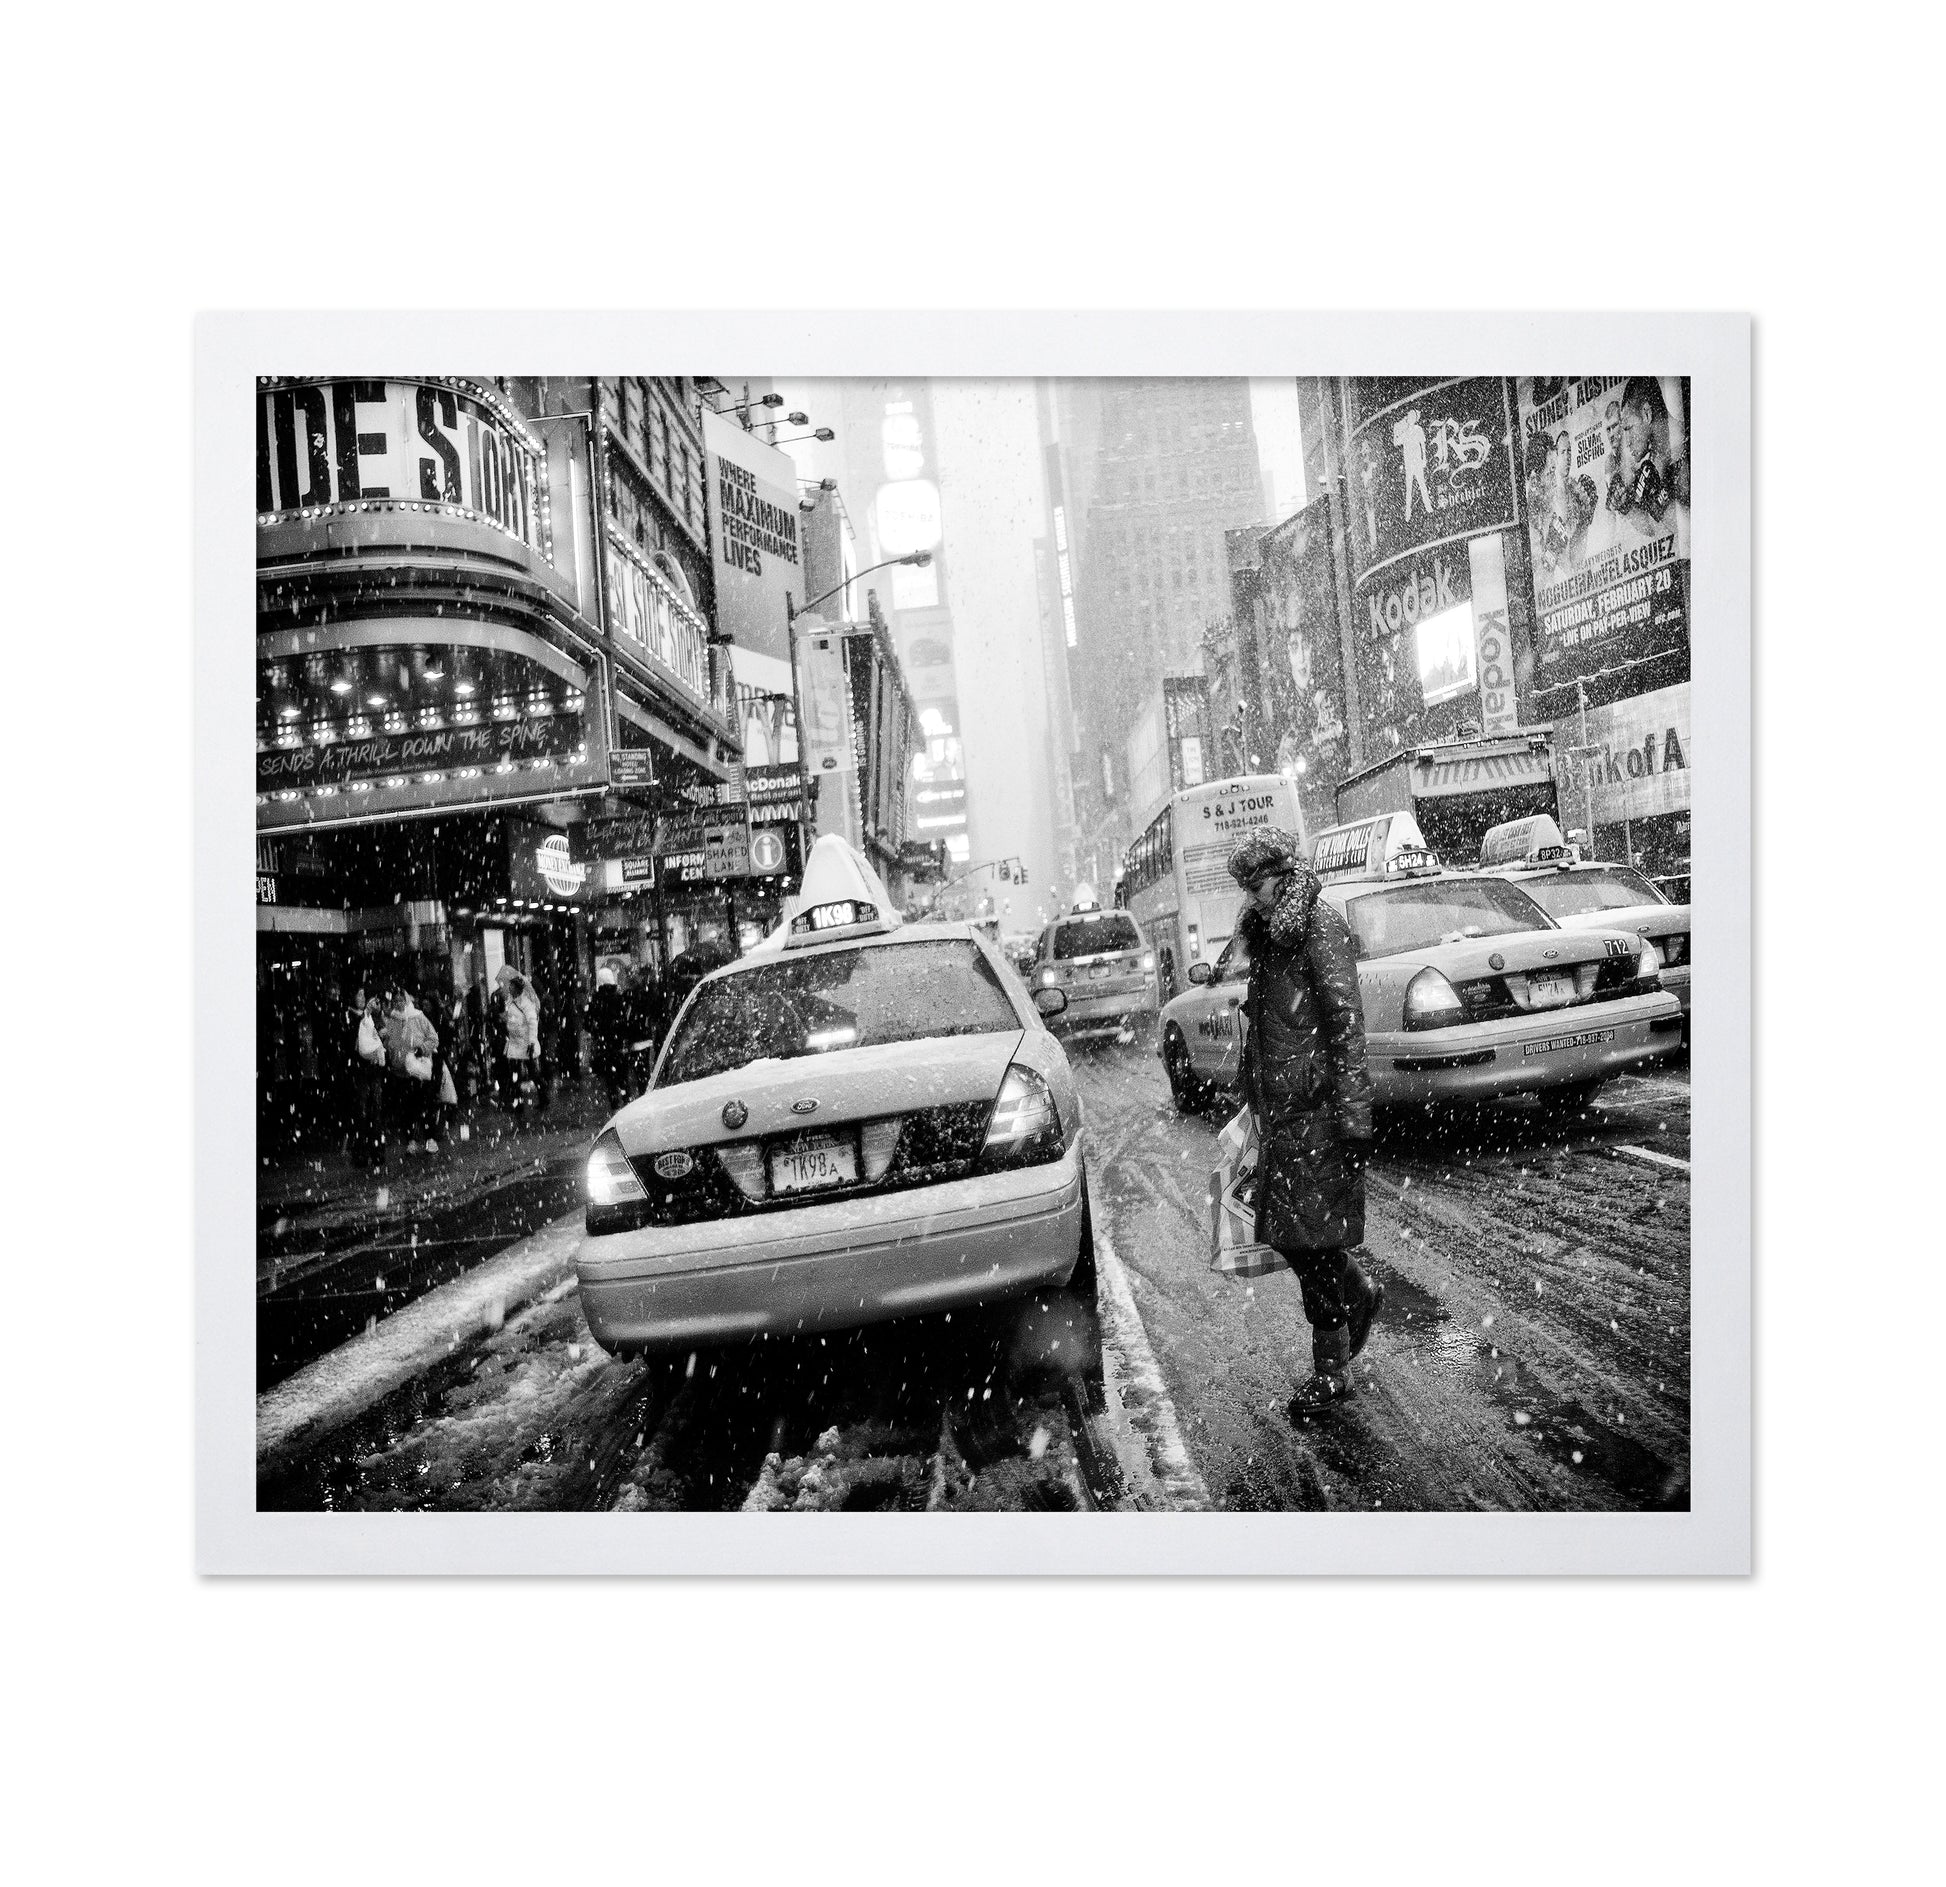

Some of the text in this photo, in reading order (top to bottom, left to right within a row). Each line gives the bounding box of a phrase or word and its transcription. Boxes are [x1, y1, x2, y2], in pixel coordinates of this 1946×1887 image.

[718, 456, 756, 494] WHERE
[720, 479, 796, 543] MAXIMUM
[722, 512, 798, 565] PERFORMANCE
[723, 536, 761, 577] LIVES
[1600, 533, 1676, 586] VELASQUEZ
[1368, 558, 1456, 639] Kodak
[1598, 574, 1653, 614] FEBRUARY
[1656, 568, 1671, 593] 20
[1563, 626, 1580, 648] LIVE
[1580, 622, 1592, 640] ON
[1478, 607, 1513, 732] Kodak
[260, 749, 315, 776] SENDS
[318, 748, 333, 774] A
[336, 742, 399, 768] THRILL
[402, 733, 454, 759] DOWN
[460, 728, 492, 750] THE
[1627, 733, 1655, 778] of
[1203, 795, 1274, 819] S & J TOUR
[706, 846, 747, 860] SHARED
[714, 860, 741, 873] LANE
[1399, 852, 1424, 869] 5H24
[1541, 848, 1560, 860] 8P32
[681, 866, 706, 880] CEN
[812, 902, 853, 929] 1K98
[1604, 940, 1629, 956] 712
[1525, 1041, 1550, 1055] DRIVERS
